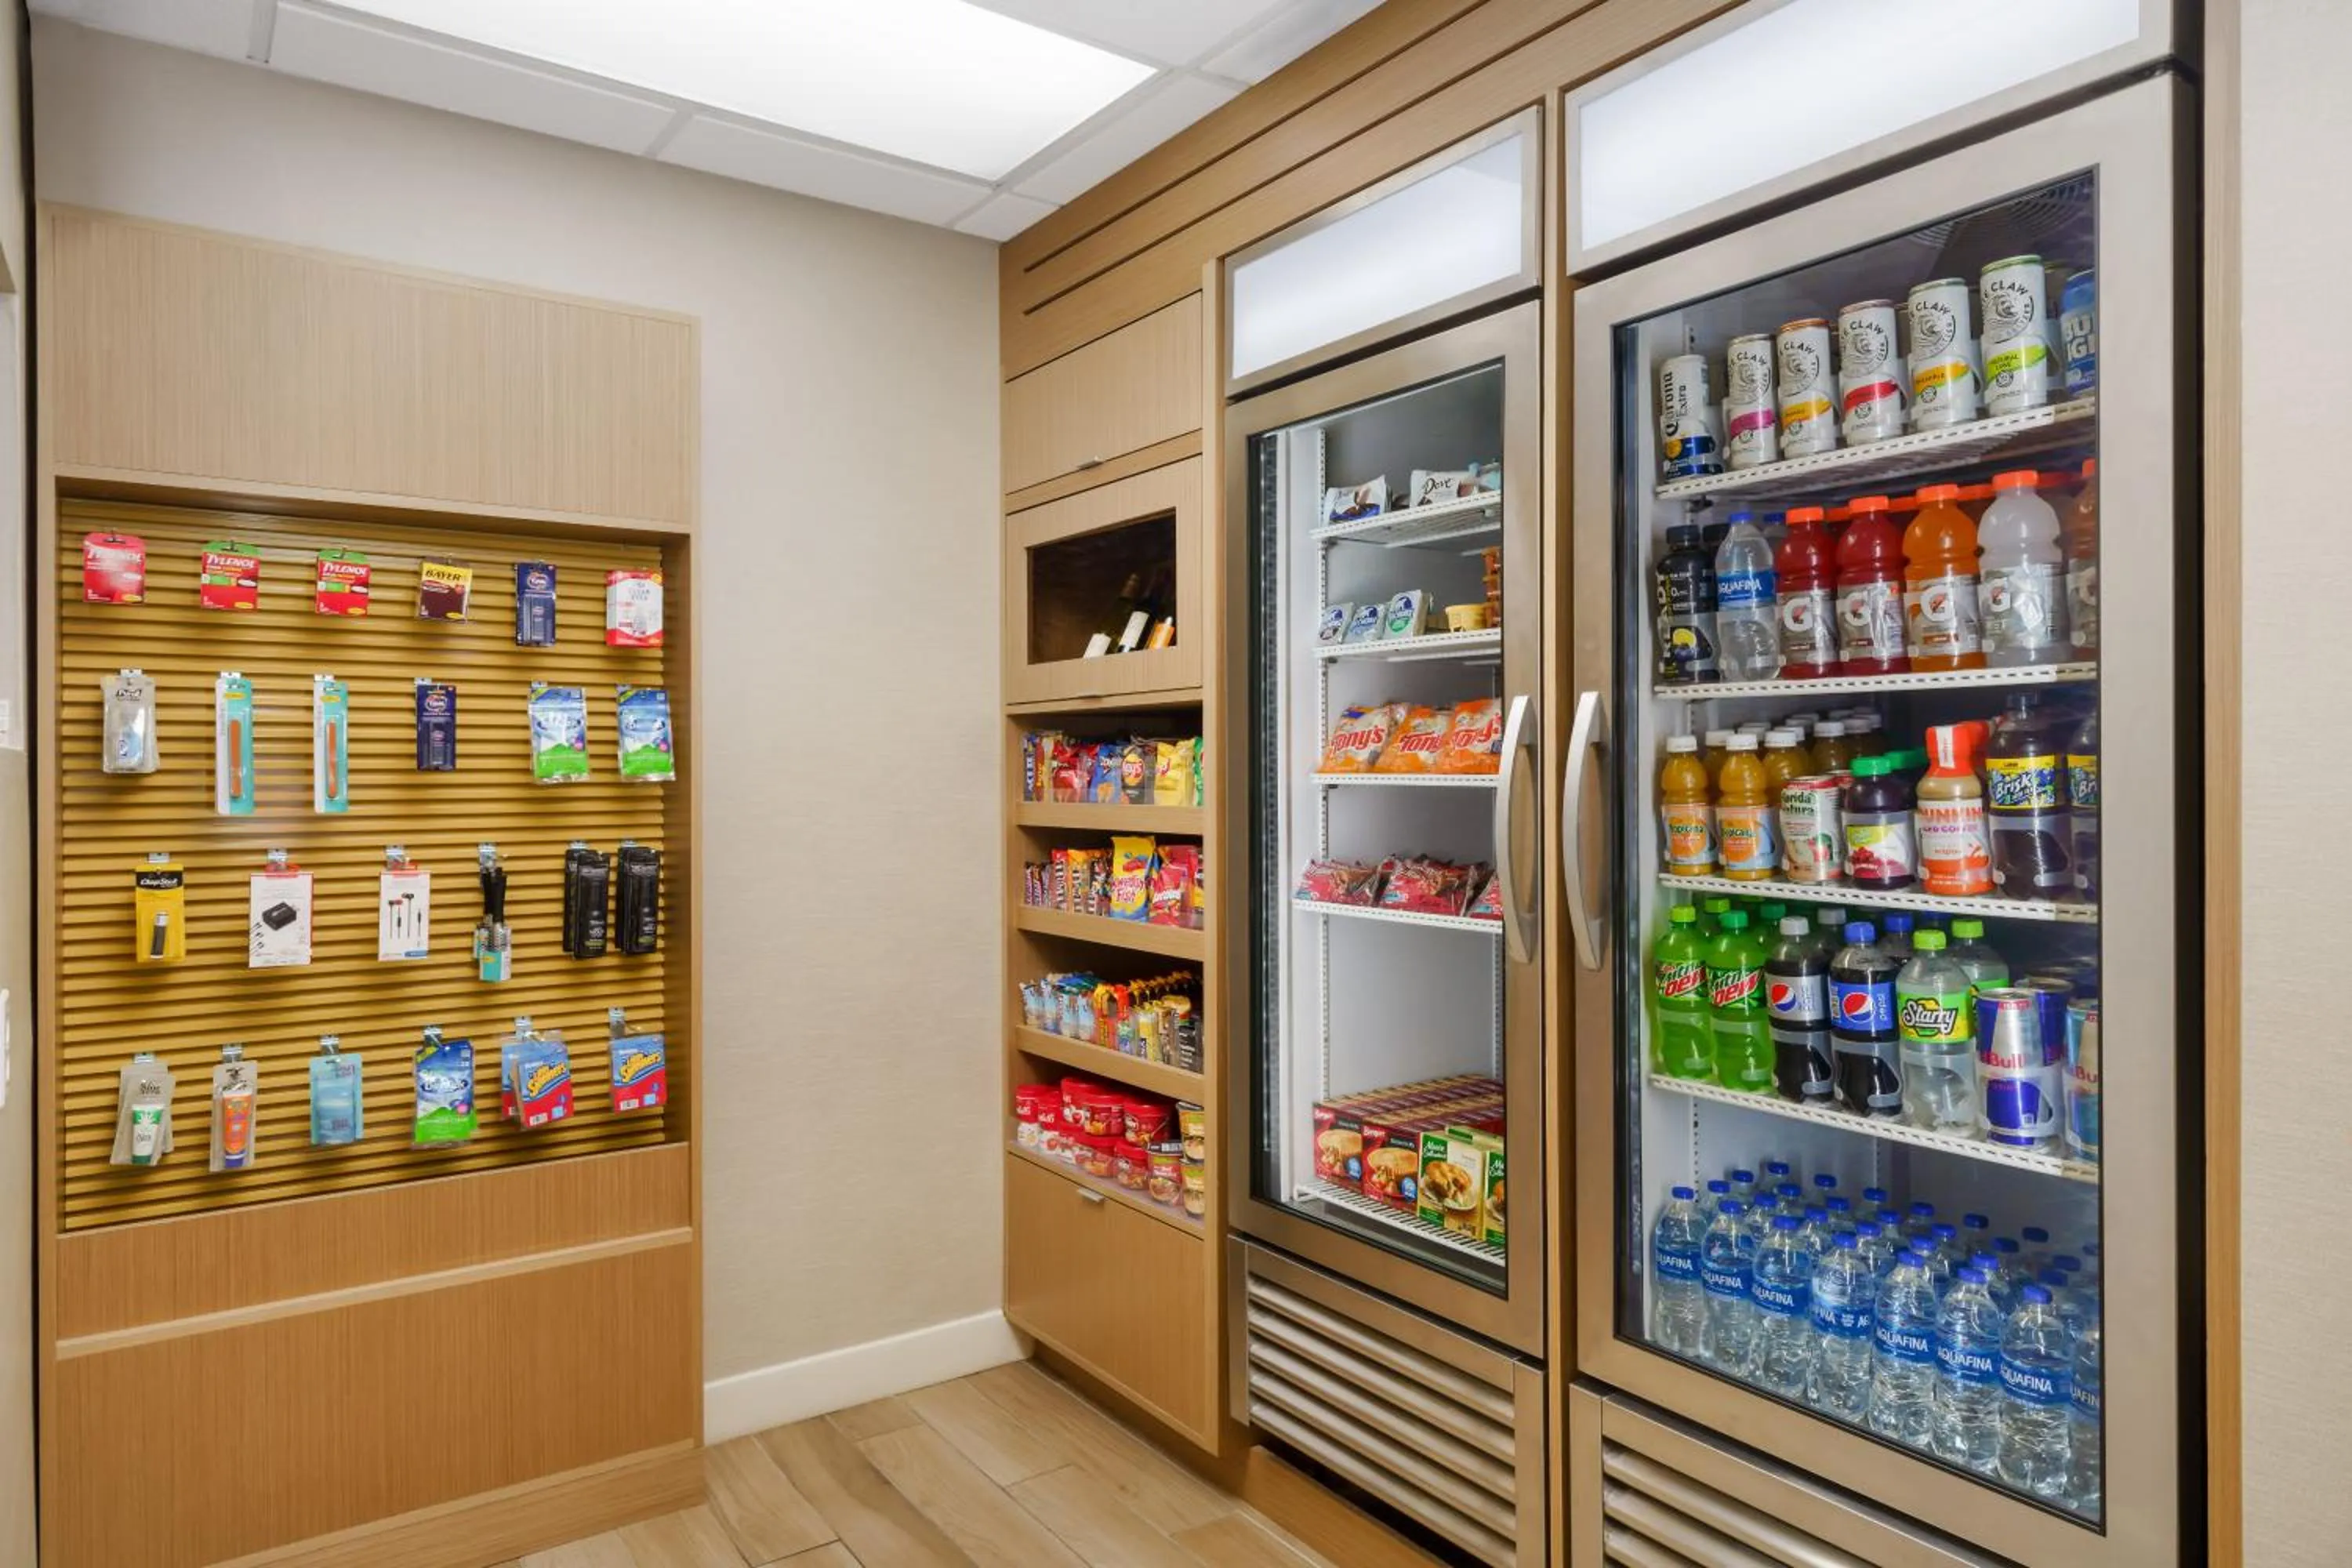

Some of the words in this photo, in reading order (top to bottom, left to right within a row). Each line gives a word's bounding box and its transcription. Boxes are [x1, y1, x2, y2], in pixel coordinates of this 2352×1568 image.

[1991, 280, 2028, 296] CLAW
[1915, 301, 1951, 314] CLAW
[1850, 319, 1884, 335] CLAW
[1784, 342, 1816, 355] CLAW
[425, 569, 462, 581] BAYER
[1994, 771, 2031, 800] Brisk
[2078, 779, 2097, 798] Bri
[1903, 1001, 1956, 1033] Starry
